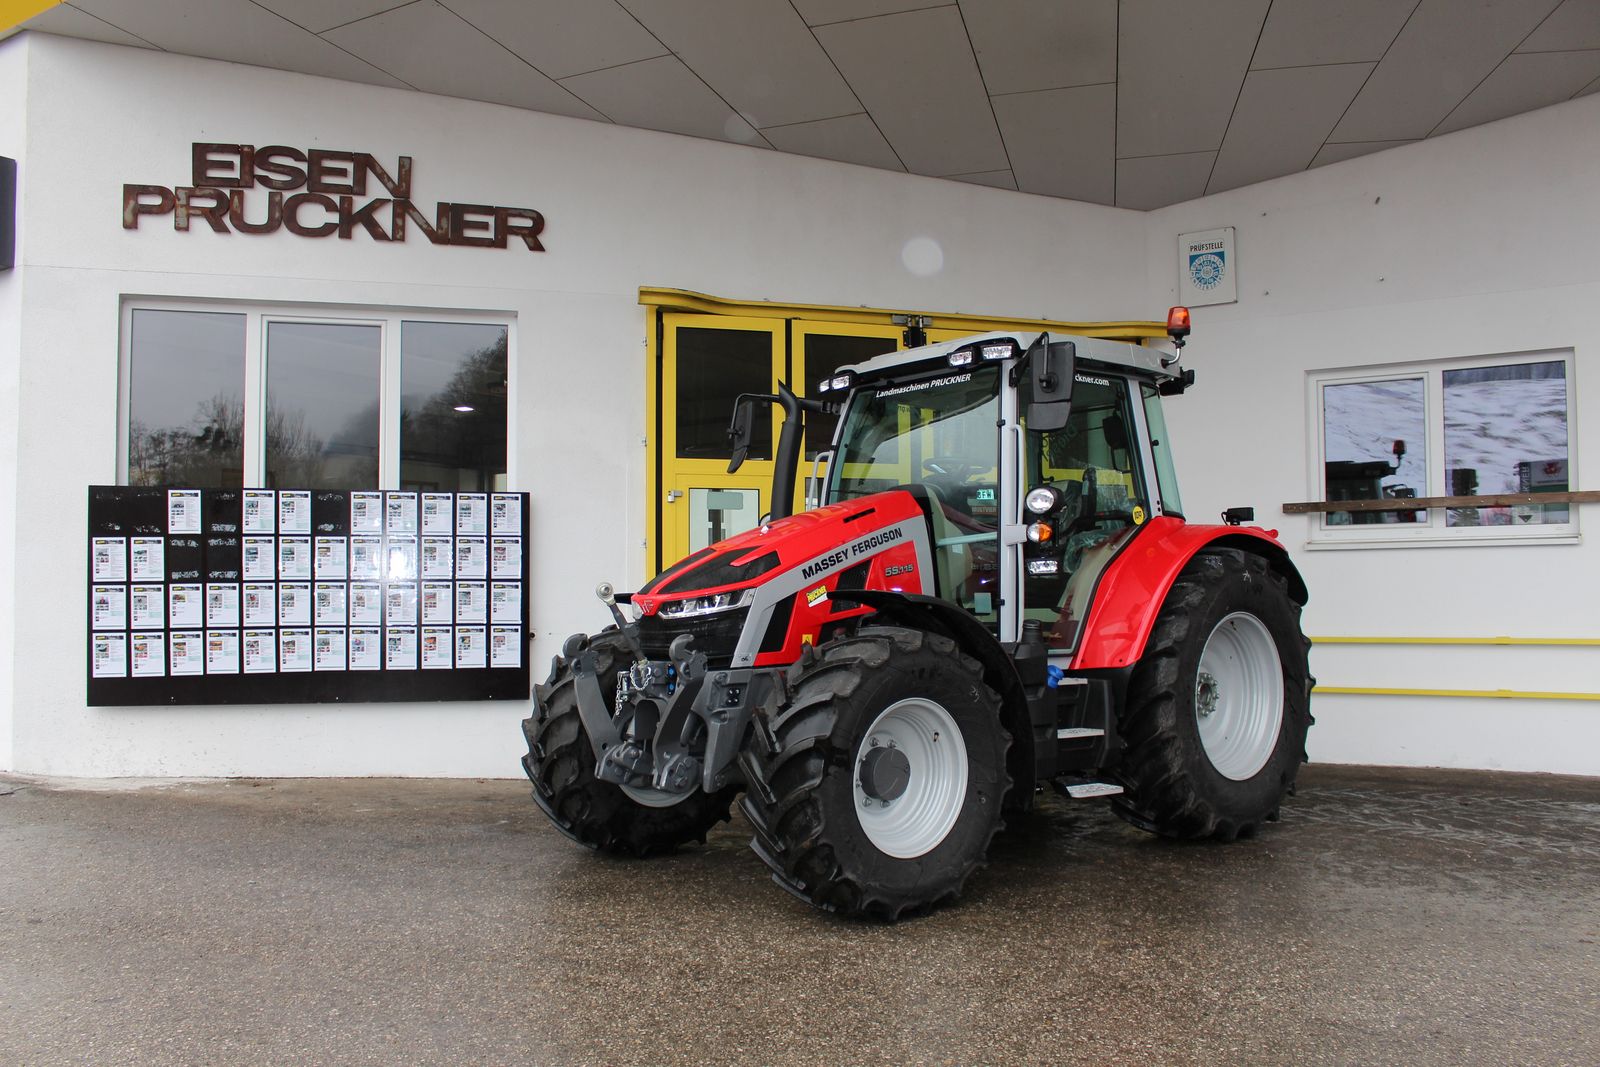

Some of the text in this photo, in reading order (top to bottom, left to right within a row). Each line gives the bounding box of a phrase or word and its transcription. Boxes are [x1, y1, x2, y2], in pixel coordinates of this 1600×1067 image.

[192, 142, 412, 199] EISEN
[123, 183, 546, 252] PRUCKNER
[876, 373, 972, 398] Landmaschinen PRUCKNER
[1074, 373, 1110, 387] ckner.com
[801, 527, 903, 580] MASSEY FERGUSON
